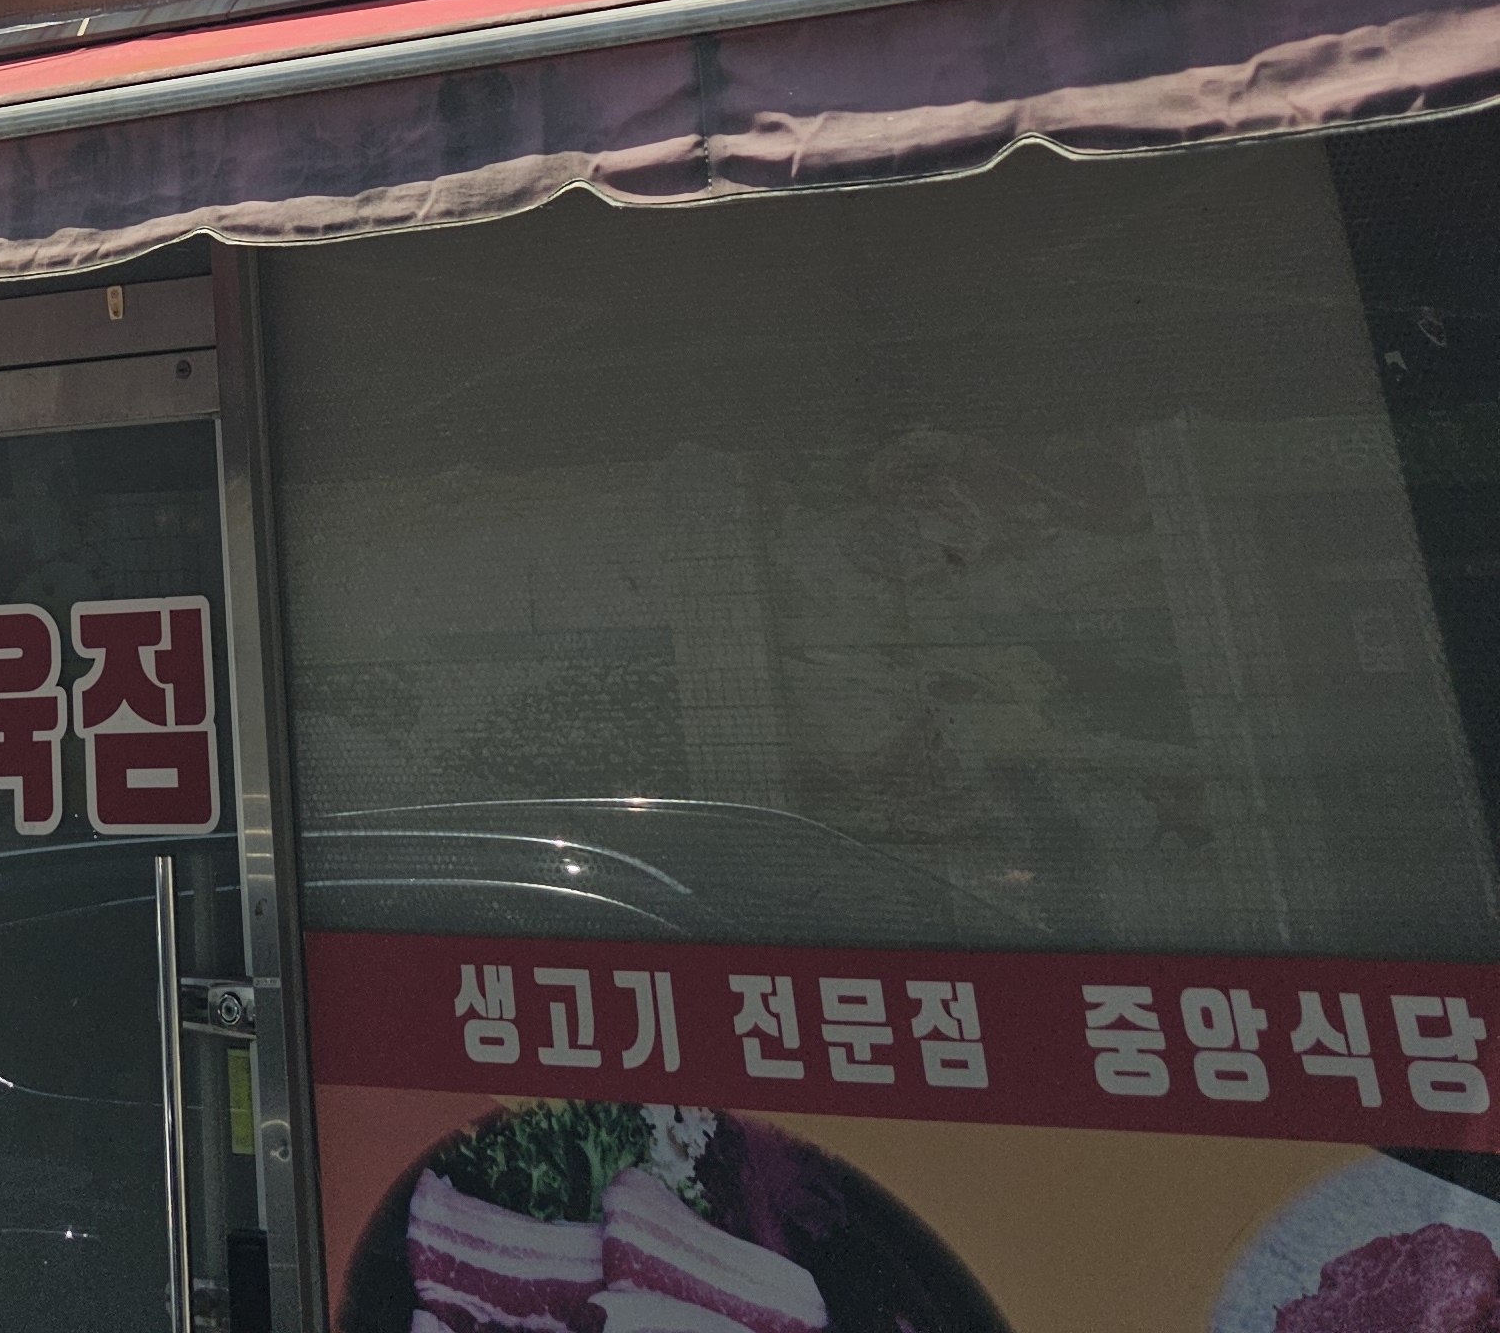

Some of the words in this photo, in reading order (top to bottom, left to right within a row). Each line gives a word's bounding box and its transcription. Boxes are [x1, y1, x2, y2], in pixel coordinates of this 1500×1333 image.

[453, 964, 682, 1073] 생고기
[727, 974, 989, 1091] 전문점
[1081, 983, 1491, 1116] 중앙식당
